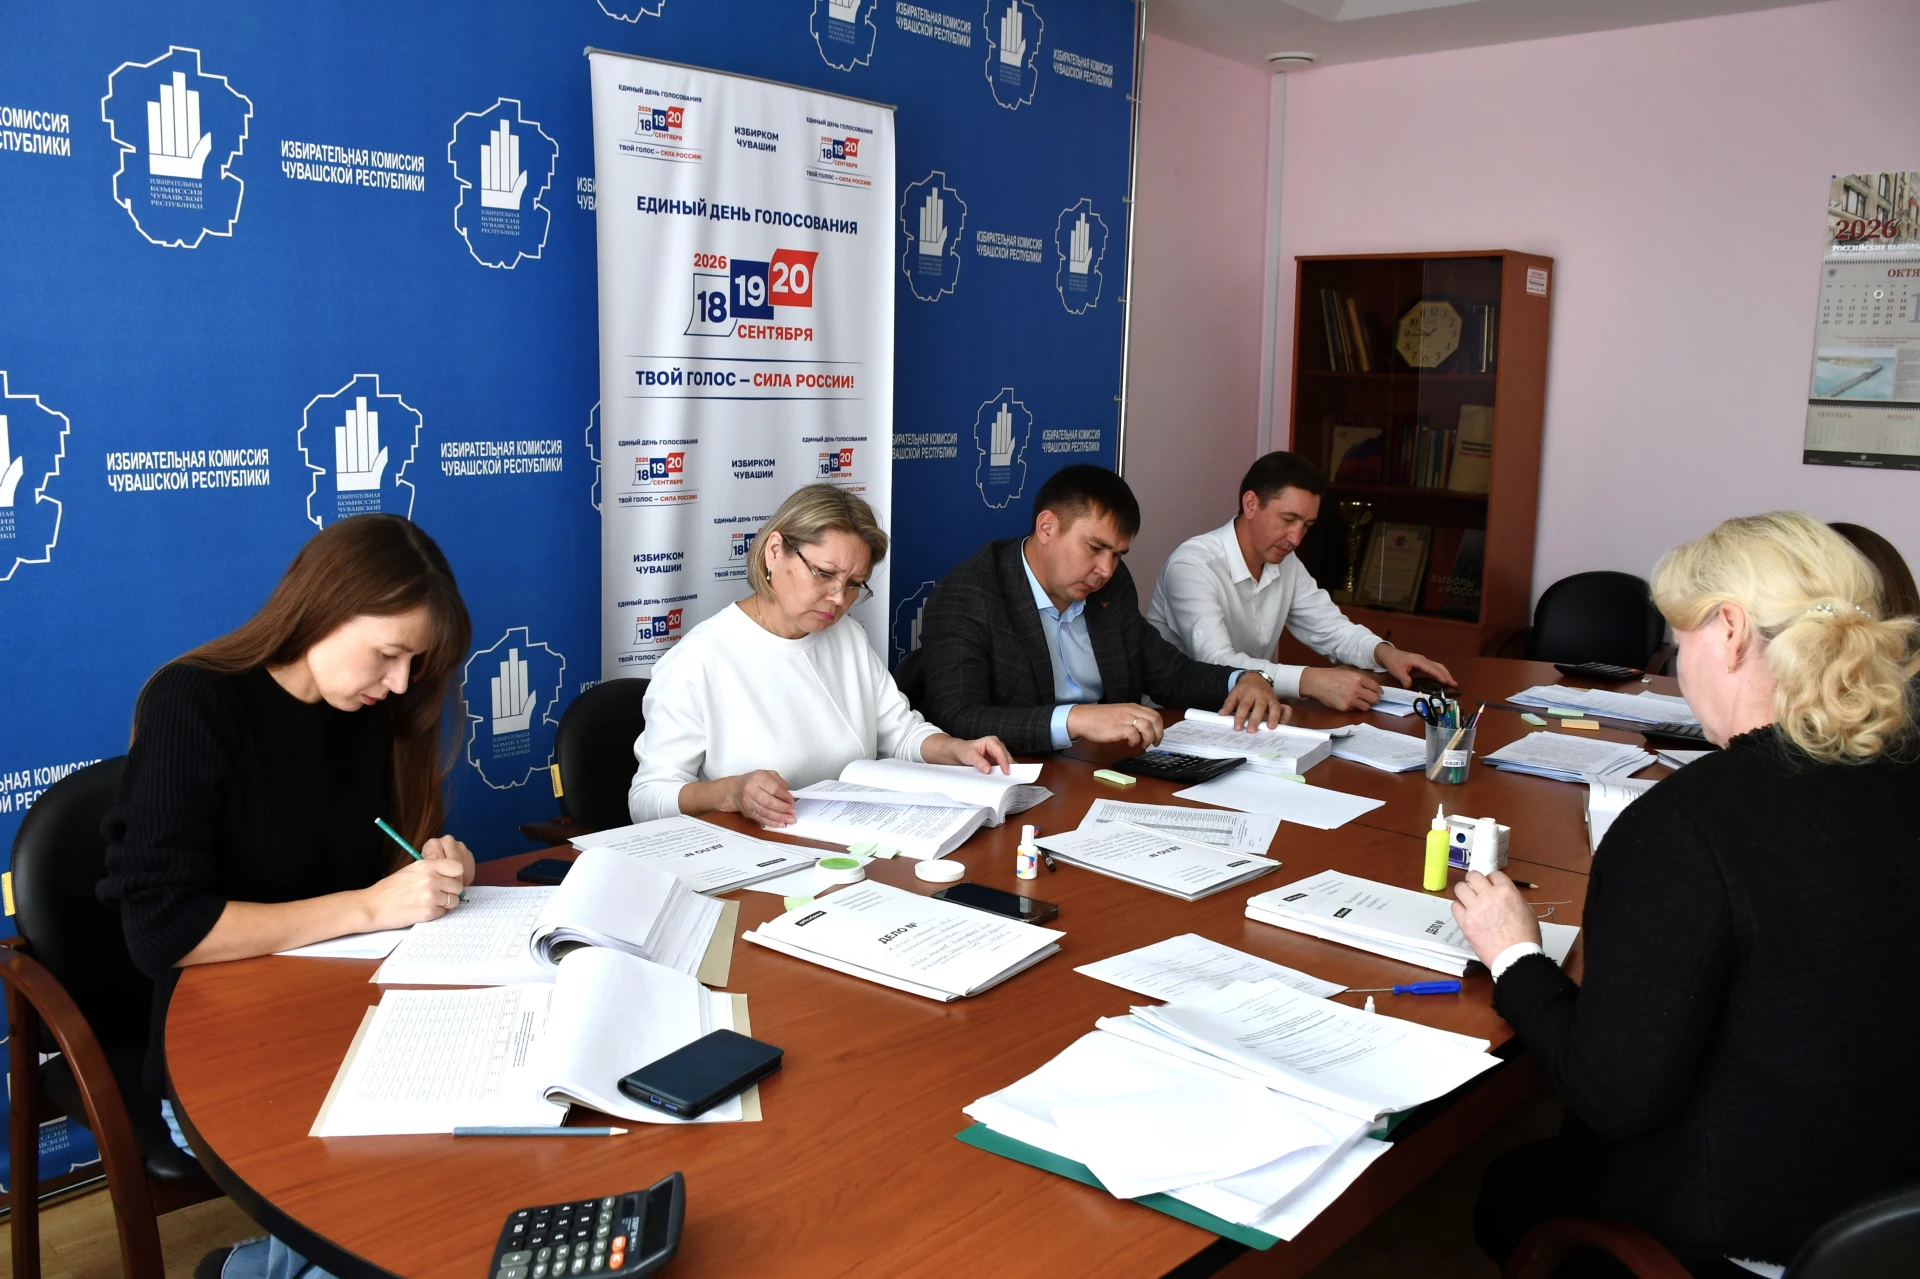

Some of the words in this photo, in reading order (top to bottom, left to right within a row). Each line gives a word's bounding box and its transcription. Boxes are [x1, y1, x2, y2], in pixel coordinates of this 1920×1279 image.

[896, 2, 942, 25] ИЗБИРАТЕЛЬНАЯ
[943, 15, 971, 34] КОМИССИЯ
[896, 16, 933, 36] ЧУВАШСКОЙ
[934, 27, 971, 48] РЕСПУБЛИКИ
[1054, 49, 1090, 68] ИЗБИРАТЕЛЬНАЯ
[1090, 59, 1114, 75] КОМИССИЯ
[1053, 62, 1083, 81] ЧУВАШСКОЙ
[1083, 72, 1113, 88] РЕСПУБЛИКИ
[619, 84, 644, 94] ЕДИНЫЙ
[645, 89, 660, 97] ДЕНЬ
[661, 92, 702, 103] ГОЛОСОВАНИЯ
[0, 106, 70, 134] ОМИССИЯ
[640, 119, 652, 131] 18
[654, 115, 666, 127] 19
[668, 111, 681, 123] 20
[806, 117, 826, 126] ЕДИНЫЙ
[840, 123, 873, 134] ГОЛОСОВАНИЯ
[655, 132, 682, 141] СЕНТЯБРЯ
[735, 126, 779, 141] ИЗБИРКОМ
[619, 144, 635, 152] ТВОЙ
[737, 139, 776, 153] ЧУВАШИИ
[822, 148, 832, 159] 18
[834, 144, 844, 155] 19
[846, 142, 857, 153] 20
[281, 140, 368, 166] ИЗБИРАТЕЛЬНАЯ
[372, 151, 424, 172] КОМИССИЯ
[835, 160, 858, 169] СЕНТЯБРЯ
[282, 161, 353, 184] ЧУВАШСКОЙ
[356, 169, 425, 192] РЕСПУБЛИКИ
[150, 186, 203, 195] КОМИССИЯ
[637, 196, 707, 216] ЕДИНЫЙ
[710, 204, 751, 222] ДЕНЬ
[755, 209, 858, 235] ГОЛОСОВАНИЯ
[1835, 218, 1898, 240] 2026
[977, 230, 1016, 246] ИЗБИРАТЕЛЬНАЯ
[1017, 238, 1042, 250] КОМИССИЯ
[977, 244, 1008, 259] ЧУВАШСКОЙ
[1010, 250, 1042, 263] РЕСПУБЛИКИ
[694, 253, 727, 269] 2026
[698, 291, 727, 323] 18
[735, 275, 766, 307] 19
[772, 262, 810, 294] 20
[1430, 308, 1439, 316] 12
[1410, 319, 1418, 327] 10
[1450, 319, 1455, 327] 2
[738, 324, 813, 342] СЕНТЯБРЯ
[1452, 330, 1456, 338] 3
[1405, 342, 1410, 350] 8
[1412, 352, 1418, 360] 7
[1436, 352, 1441, 360] 5
[636, 368, 682, 386] ТВОЙ
[687, 372, 736, 386] ГОЛОС
[754, 373, 792, 387] СИЛА
[796, 374, 854, 388] РОССИИ!
[892, 434, 929, 445] БИРАТЕЛЬНАЯ
[930, 433, 958, 444] КОМИССИЯ
[1043, 430, 1077, 441] ИЗБИРАТЕЛЬНАЯ
[1078, 430, 1100, 440] КОМИССИЯ
[441, 441, 514, 458] ИЗБИРАТЕЛЬНАЯ
[517, 440, 562, 455] КОМИССИЯ
[892, 446, 920, 459] ВАШСКОЙ
[922, 447, 957, 458] РЕСПУБЛИКИ
[1042, 442, 1070, 453] ЧУВАШСКОЙ
[1072, 442, 1100, 451] РЕСПУБЛИКИ
[107, 451, 206, 470] ИЗБИРАТЕЛЬНАЯ
[209, 449, 269, 466] КОМИССИЯ
[442, 457, 501, 476] ЧУВАШСКОЙ
[504, 458, 562, 473] РЕСПУБЛИКИ
[732, 459, 775, 468] ИЗБИРКОМ
[820, 464, 829, 474] 18
[831, 458, 839, 468] 19
[840, 453, 850, 463] 20
[637, 470, 649, 480] 18
[652, 463, 665, 474] 19
[668, 457, 682, 468] 20
[734, 471, 773, 479] ЧУВАШИИ
[108, 467, 188, 492] ЧУВАШСКОЙ
[192, 469, 270, 488] РЕСПУБЛИКИ
[618, 496, 632, 504] ТВОЙ
[714, 516, 736, 524] ЕДИНЫЙ
[634, 552, 684, 563] ИЗБИРКОМ
[734, 545, 744, 556] 18
[636, 564, 682, 574] ЧУВАШИИ
[1431, 575, 1476, 587] ВЫБОРЫ
[618, 599, 642, 608] ЕДИНЫЙ
[662, 594, 698, 604] ГОЛОСОВАНИЯ
[639, 628, 652, 640] 18
[654, 622, 666, 632] 19
[669, 614, 680, 626] 20
[656, 635, 682, 644] СЕНТЯБРЯ
[618, 655, 633, 663] ТВОЙ
[695, 844, 724, 854] ДЕЛО
[878, 927, 908, 944] ДЕЛО
[514, 1224, 523, 1233] 00
